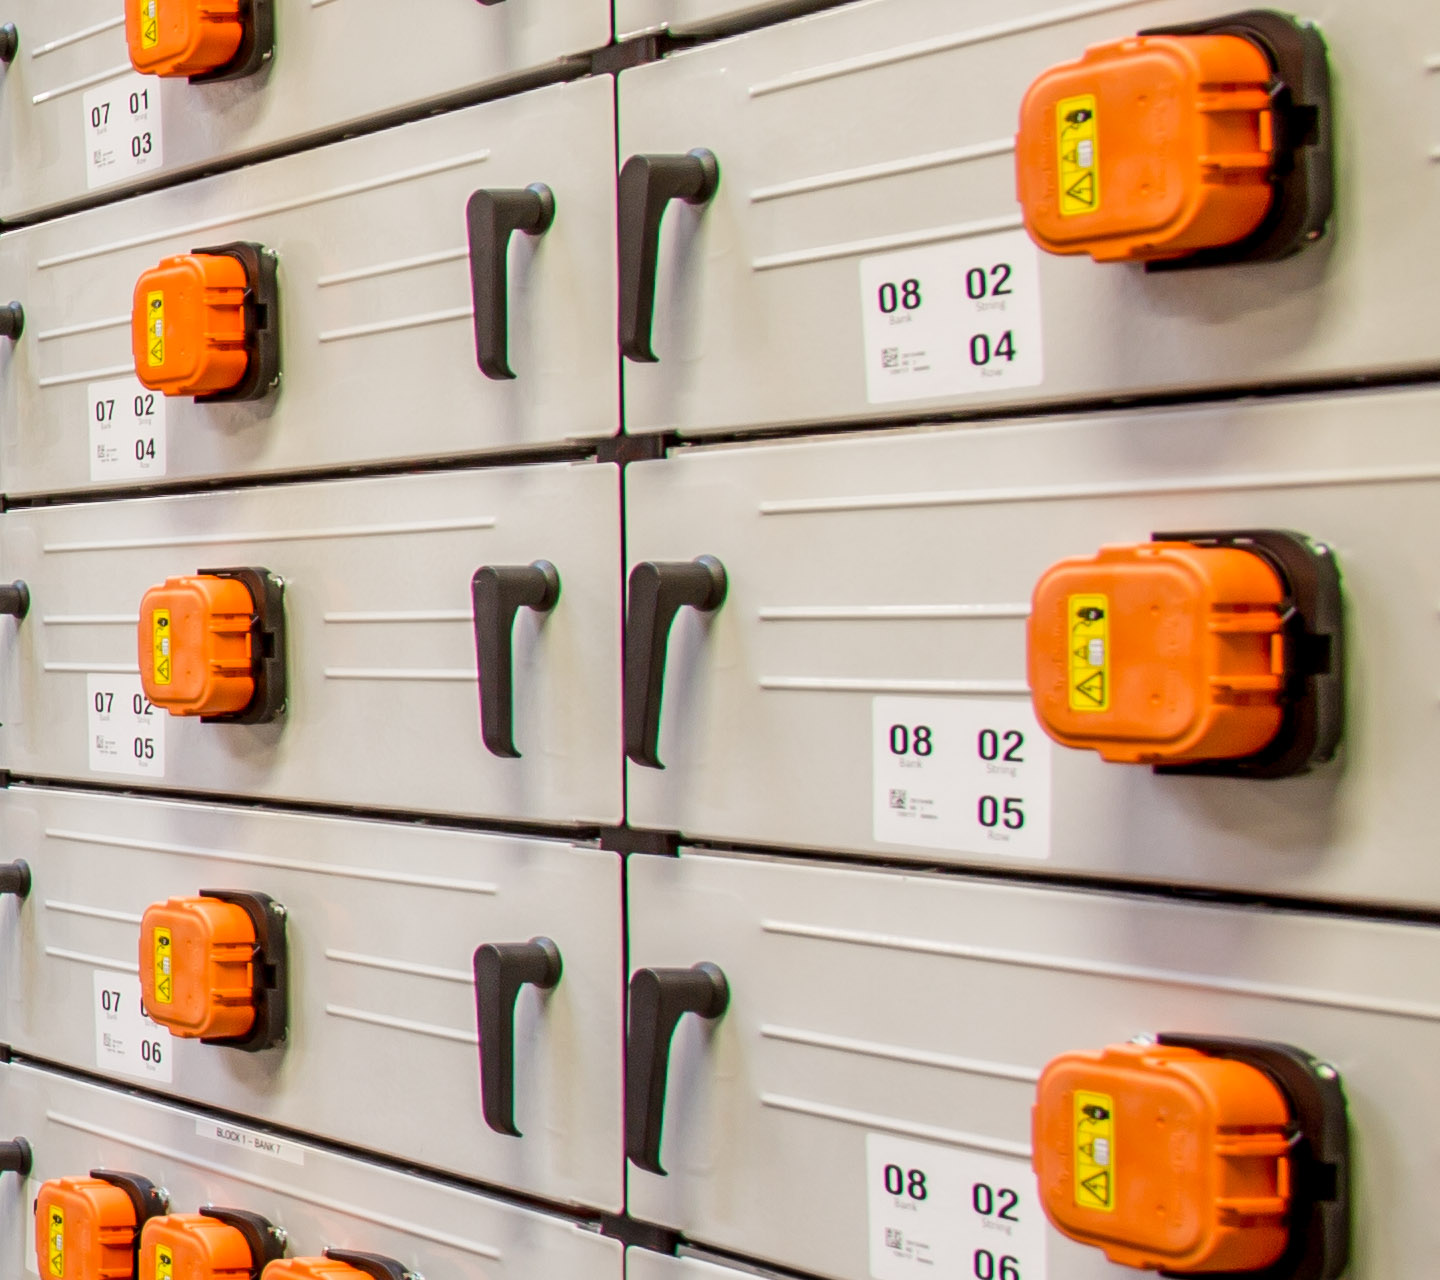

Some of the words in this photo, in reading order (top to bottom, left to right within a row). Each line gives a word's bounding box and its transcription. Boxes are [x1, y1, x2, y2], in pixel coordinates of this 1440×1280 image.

[129, 89, 148, 114] 01
[91, 102, 110, 128] 07
[131, 132, 152, 158] 03
[966, 263, 1012, 300] 02
[878, 278, 921, 314] 08
[969, 330, 1016, 366] 04
[96, 399, 115, 422] 07
[134, 394, 154, 417] 02
[135, 438, 156, 461] 04
[94, 692, 114, 713] 07
[134, 737, 154, 760] 05
[890, 724, 932, 757] 08
[978, 729, 1024, 763] 02
[978, 795, 1024, 830] 05
[101, 990, 121, 1012] 07
[141, 1039, 162, 1064] 06
[216, 1128, 240, 1142] BLOCK
[242, 1136, 246, 1144] 1
[254, 1138, 274, 1151] BANK
[276, 1144, 280, 1154] 7
[884, 1164, 927, 1201] 08
[972, 1183, 1019, 1222] 02
